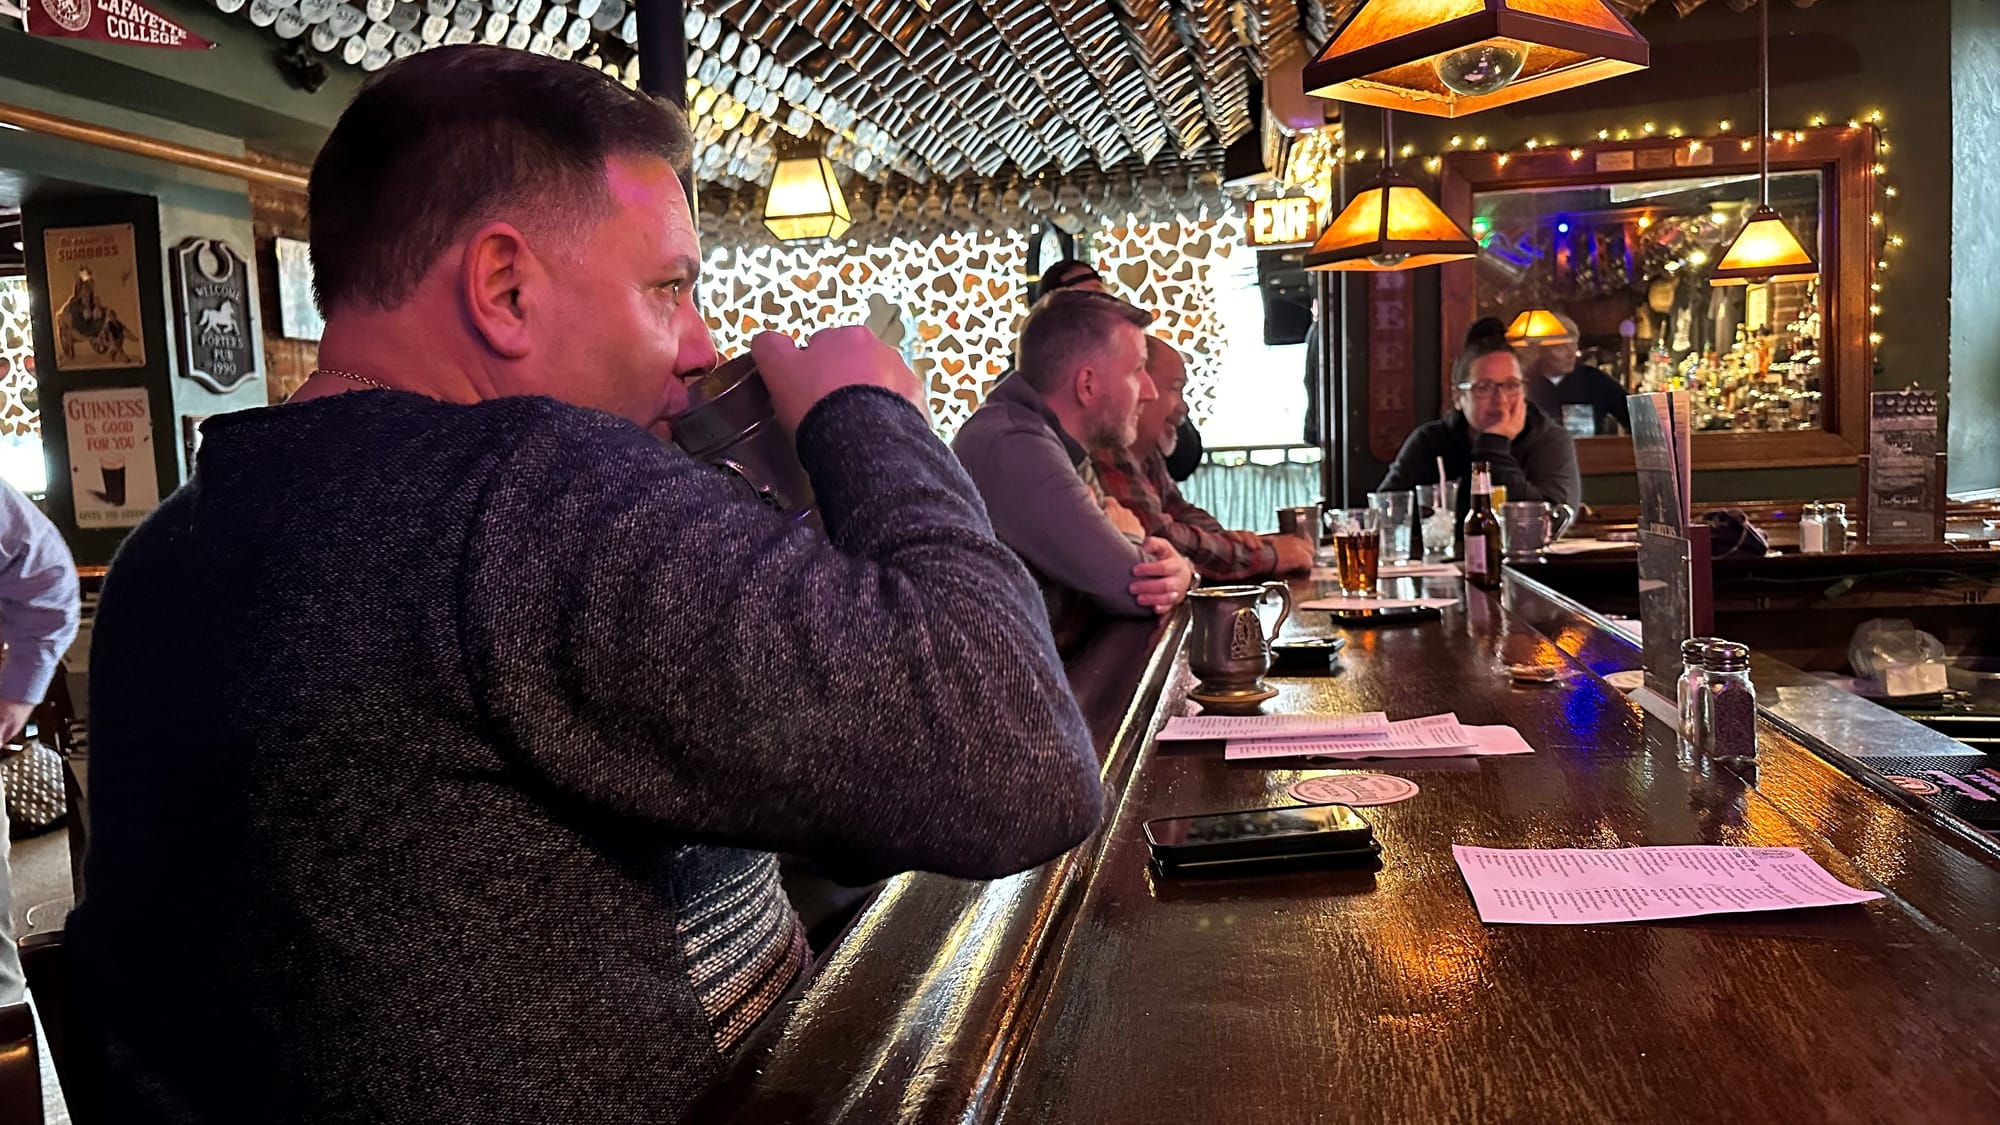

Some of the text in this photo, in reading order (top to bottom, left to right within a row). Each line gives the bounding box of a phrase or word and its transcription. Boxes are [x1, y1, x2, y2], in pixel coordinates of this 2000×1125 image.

[106, 15, 182, 45] COLLEGE
[1254, 197, 1311, 243] EXIT
[194, 284, 241, 300] WELCOME
[214, 348, 234, 361] PUB
[213, 361, 237, 376] 1990
[68, 399, 145, 420] GUINNESS
[84, 420, 134, 435] IS GOOD
[87, 434, 135, 451] FOR YOU
